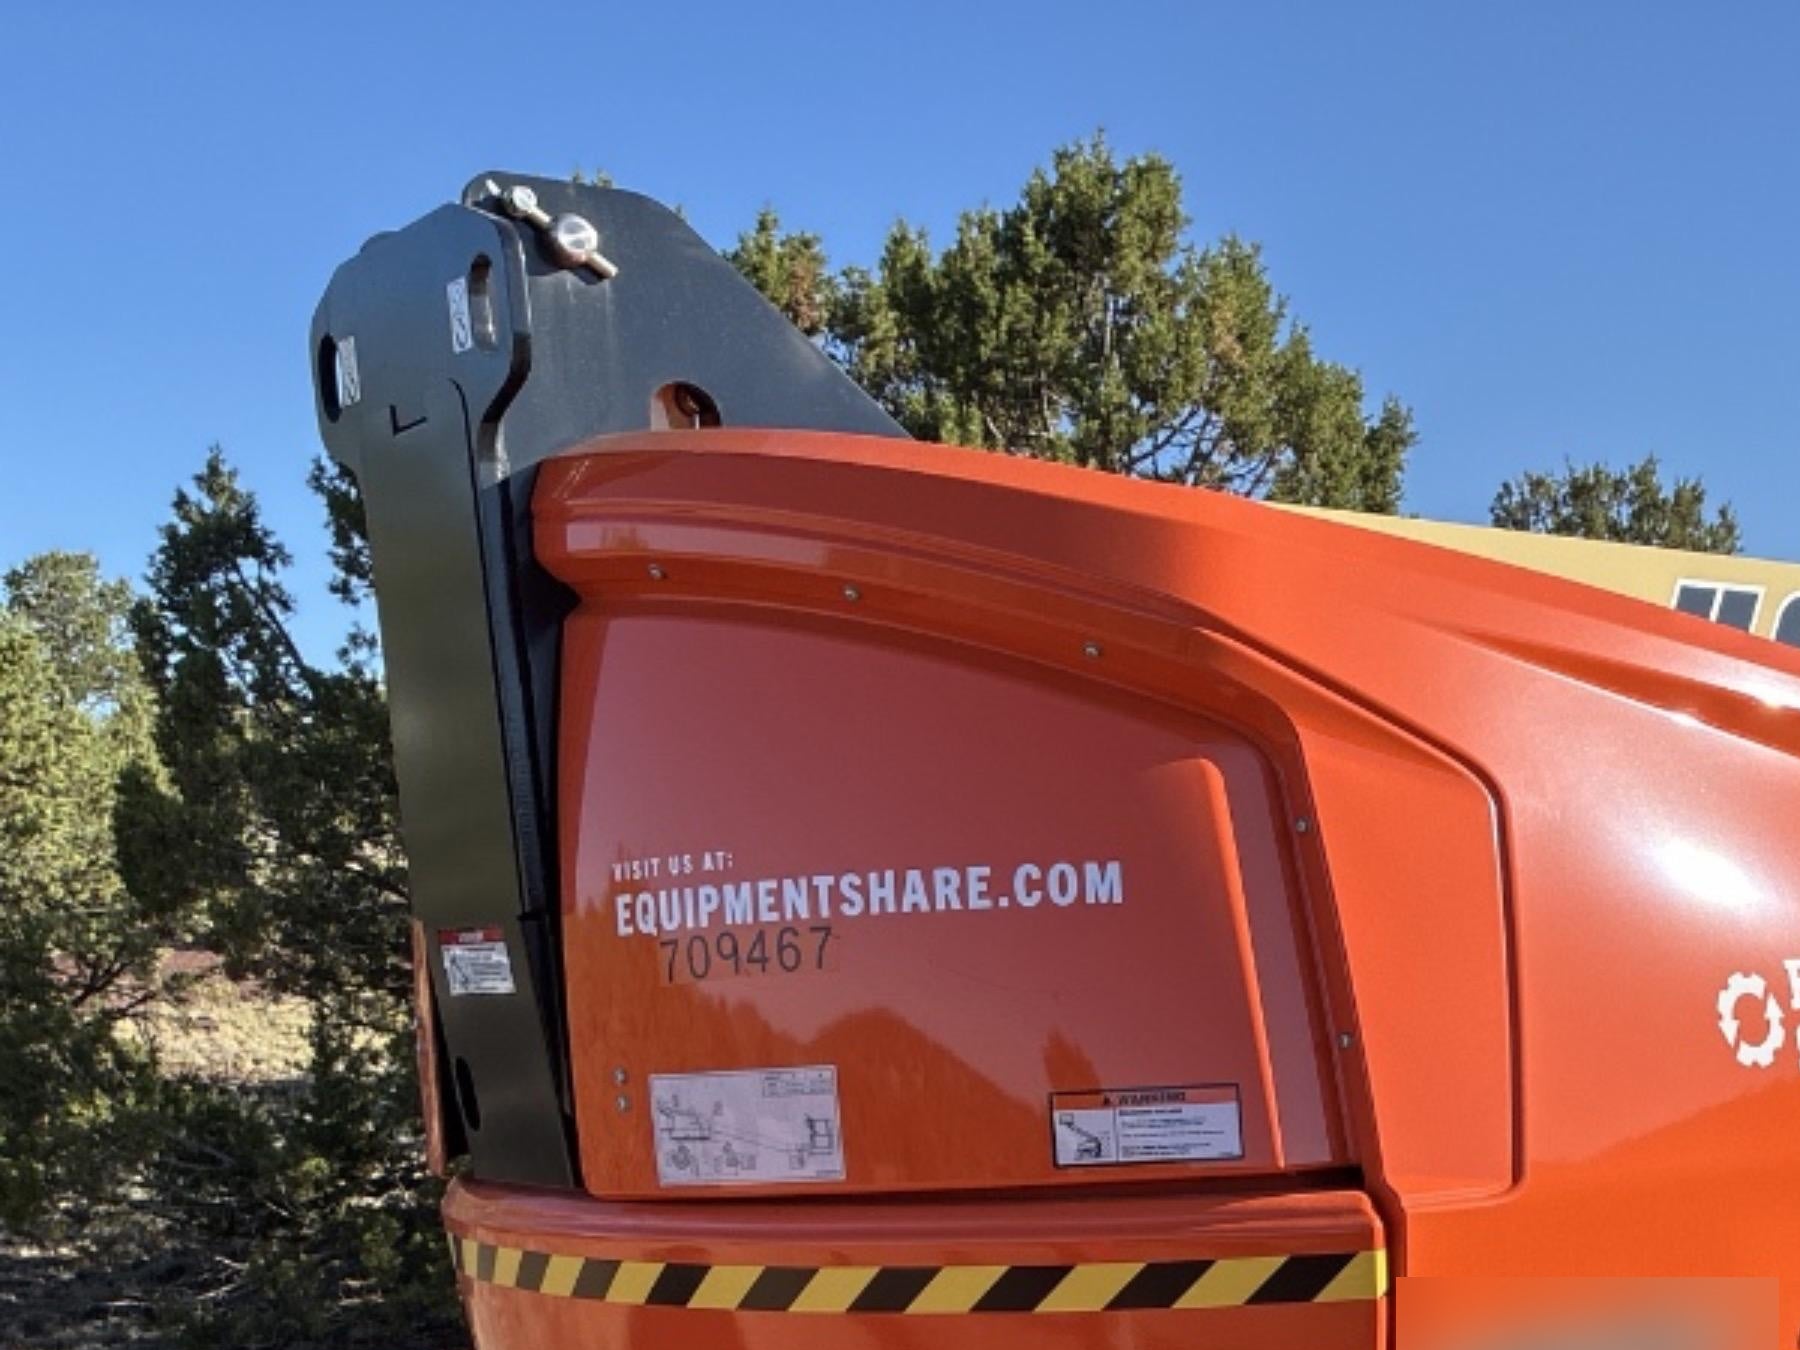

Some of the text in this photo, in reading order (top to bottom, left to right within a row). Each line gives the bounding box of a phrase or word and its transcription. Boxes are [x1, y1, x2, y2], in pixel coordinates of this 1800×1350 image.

[612, 851, 733, 882] VISIT US AT:
[614, 861, 1124, 937] EQUIPMENTSHARE.COM
[660, 925, 833, 984] 709467
